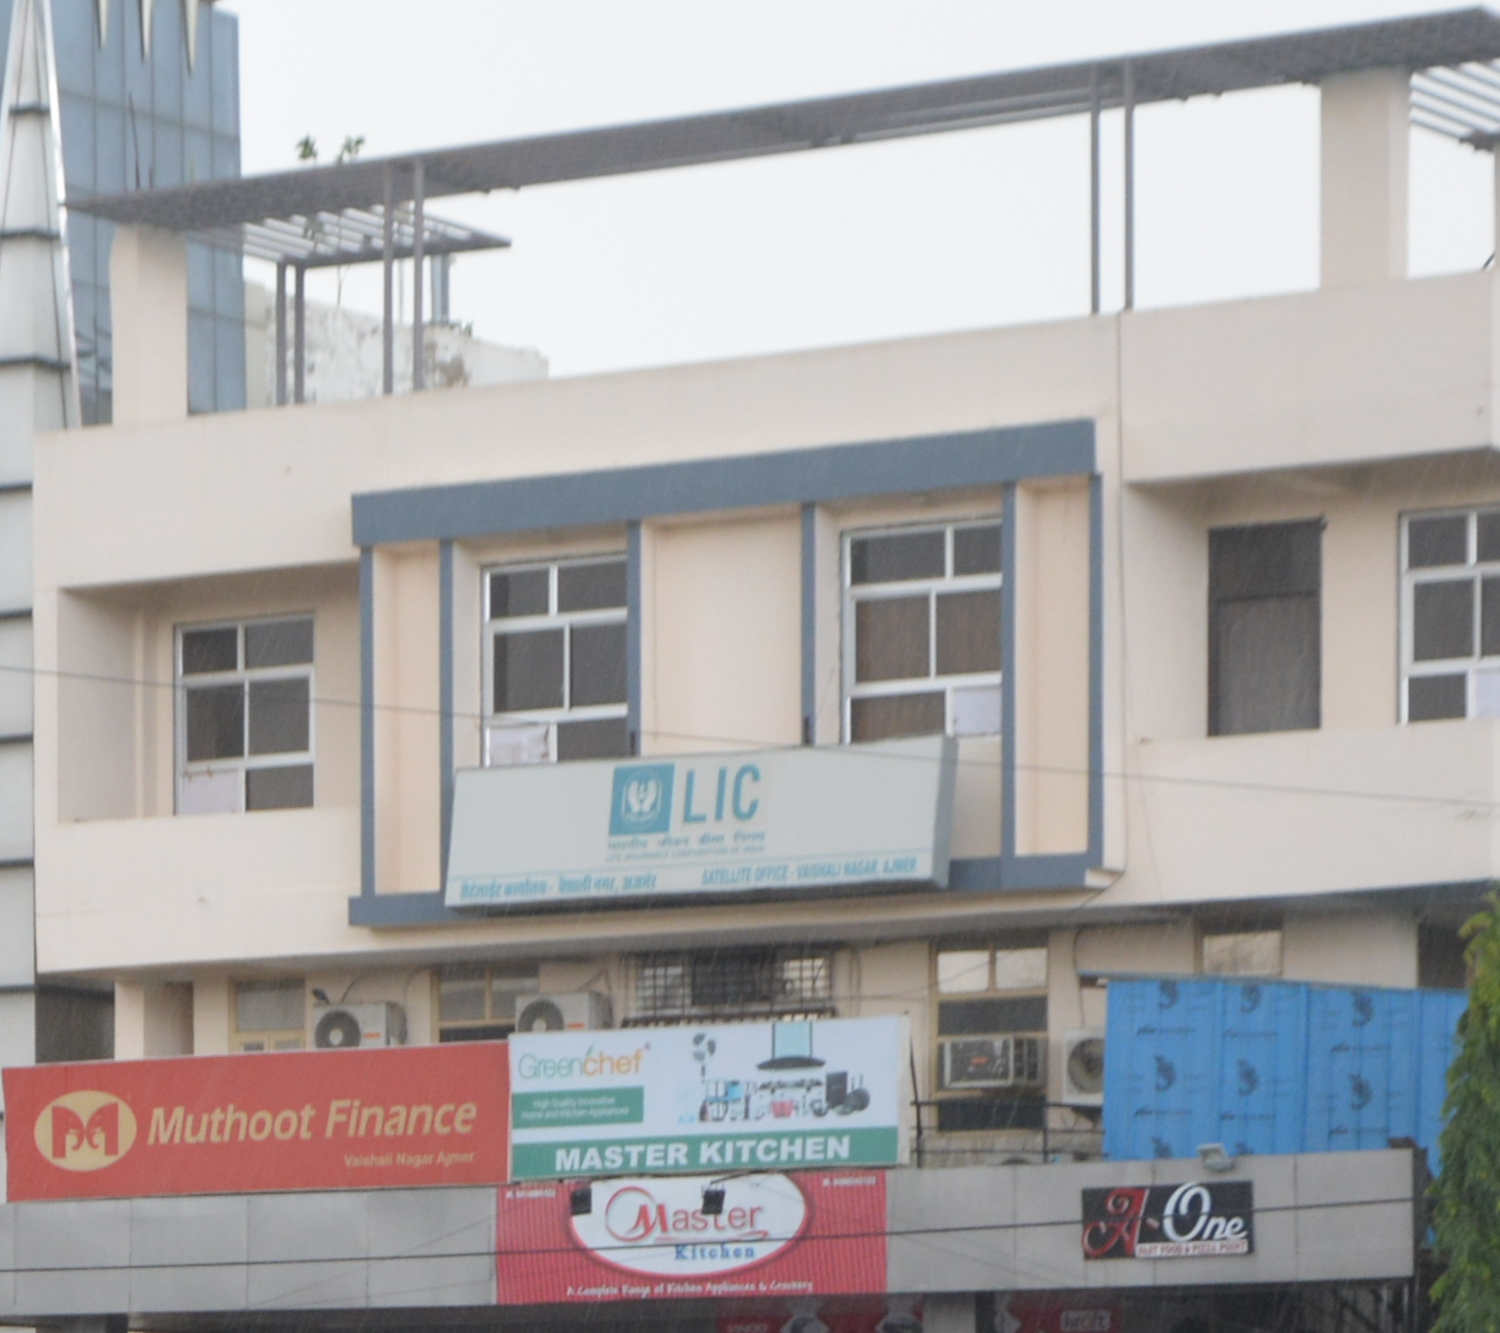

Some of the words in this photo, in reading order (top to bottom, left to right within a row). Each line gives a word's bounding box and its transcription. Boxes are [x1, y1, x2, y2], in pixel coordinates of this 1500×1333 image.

[683, 764, 761, 825] LIC
[518, 1046, 645, 1079] Greenchef
[147, 1104, 315, 1145] Muthoot
[324, 1098, 477, 1138] Finance
[344, 1152, 393, 1168] Vaishali
[396, 1152, 434, 1169] Nagar
[437, 1151, 476, 1168] Ajmer
[555, 1142, 688, 1172] MASTER
[699, 1136, 851, 1164] KITCHEN
[675, 1243, 755, 1260] Kitchen
